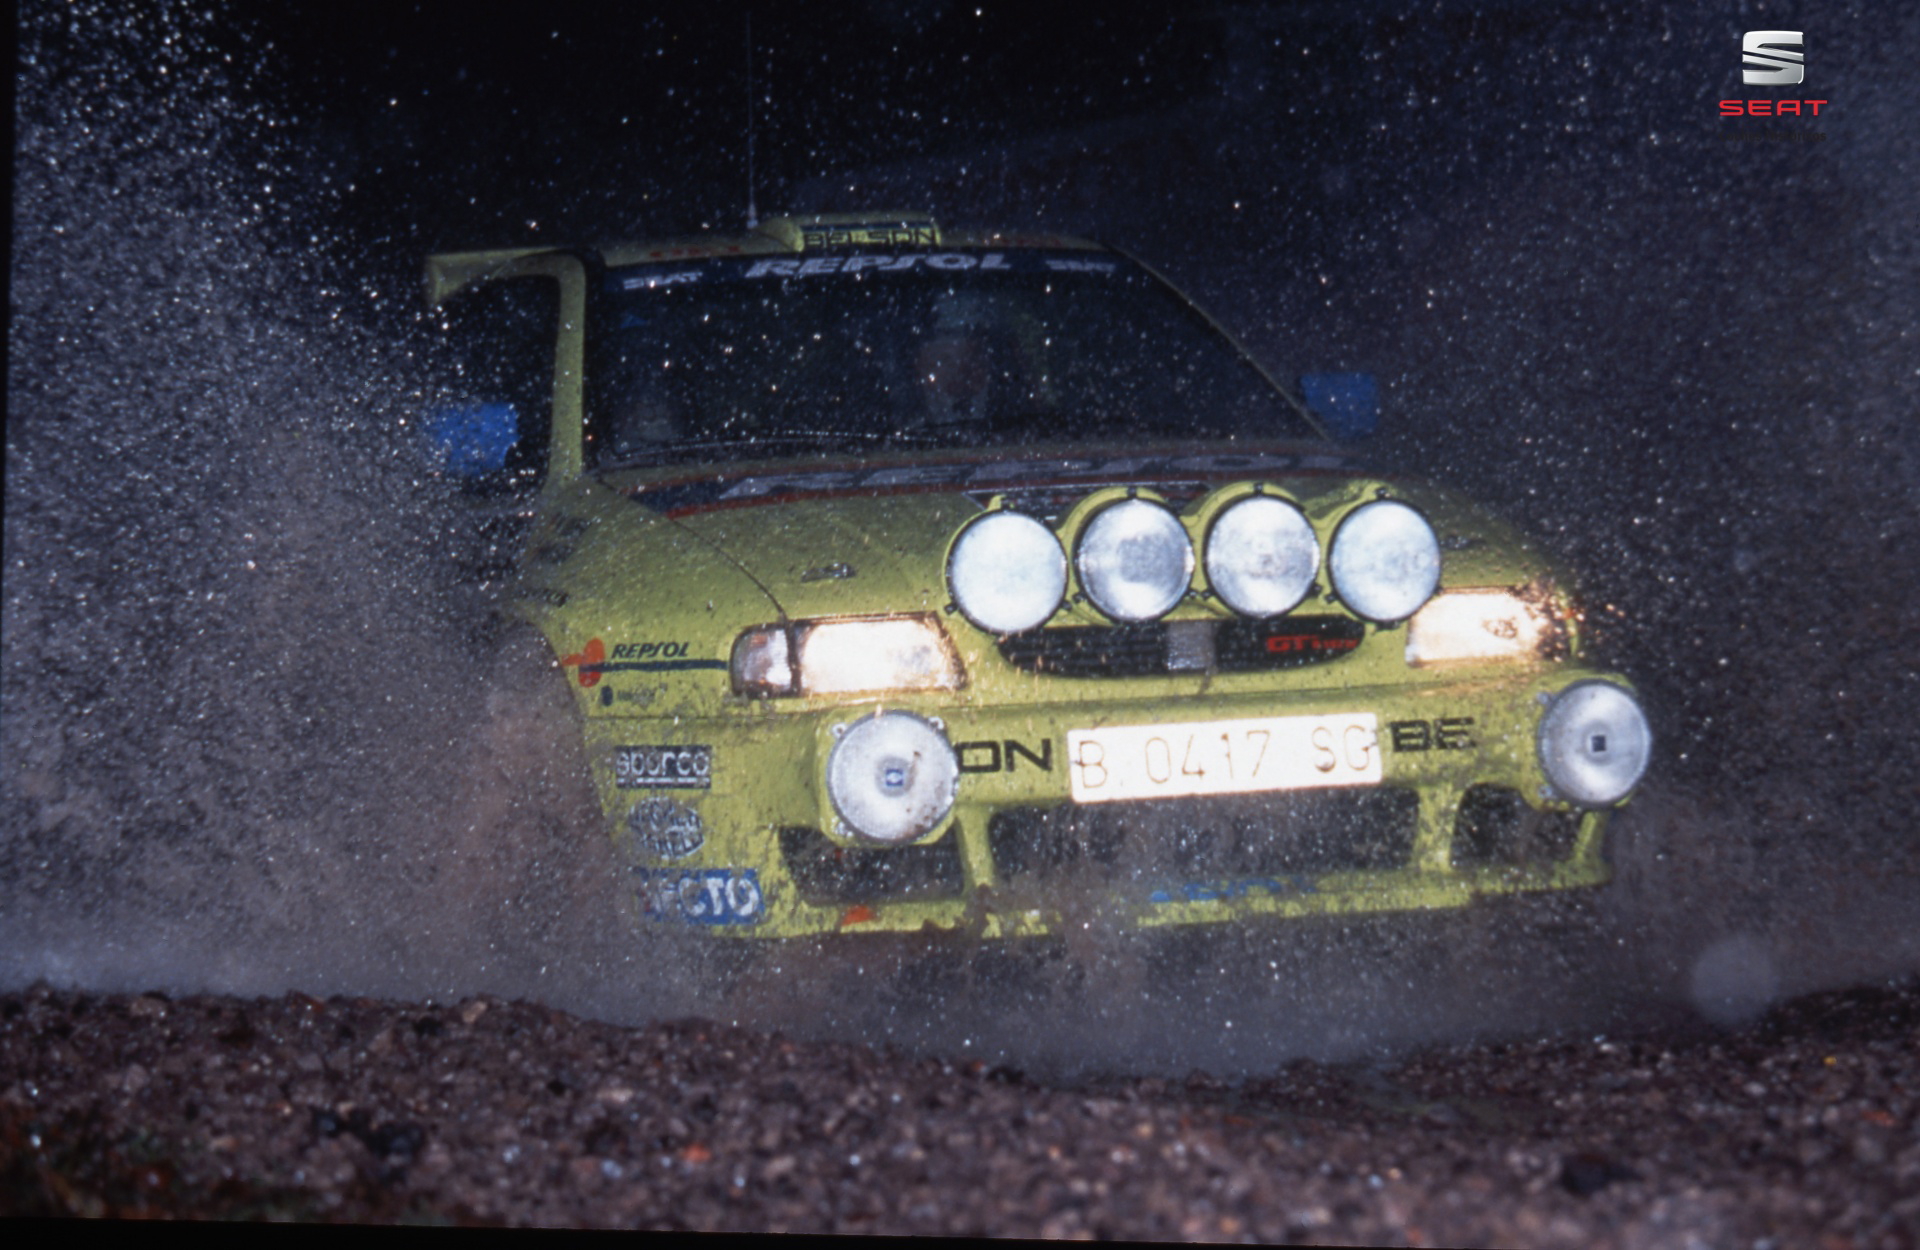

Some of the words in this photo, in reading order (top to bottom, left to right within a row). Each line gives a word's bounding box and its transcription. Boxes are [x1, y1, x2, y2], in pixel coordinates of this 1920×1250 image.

[745, 253, 1012, 278] REPSOL
[611, 642, 690, 659] REPSOL
[616, 751, 709, 776] sparco
[1078, 740, 1108, 789] B
[1145, 729, 1270, 785] 0417
[1311, 724, 1371, 774] SG
